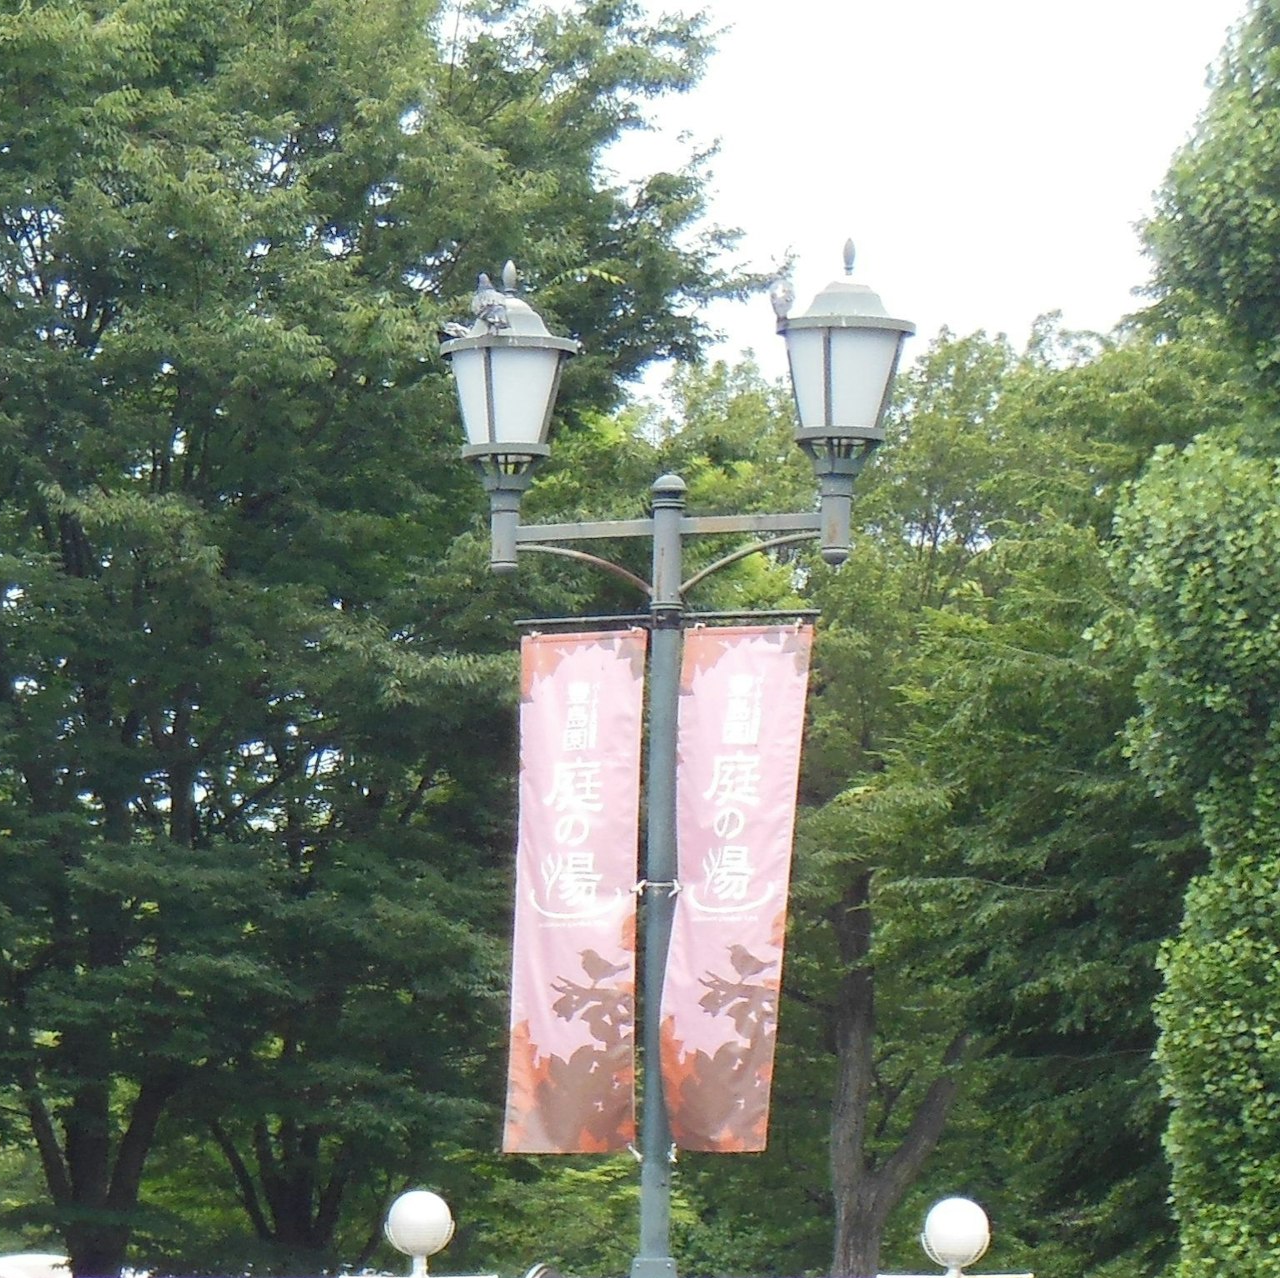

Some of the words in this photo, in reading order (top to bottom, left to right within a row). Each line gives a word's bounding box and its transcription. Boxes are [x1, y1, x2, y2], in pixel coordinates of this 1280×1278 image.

[542, 757, 604, 907] 庭の湯
[703, 750, 761, 899] 庭の湯
